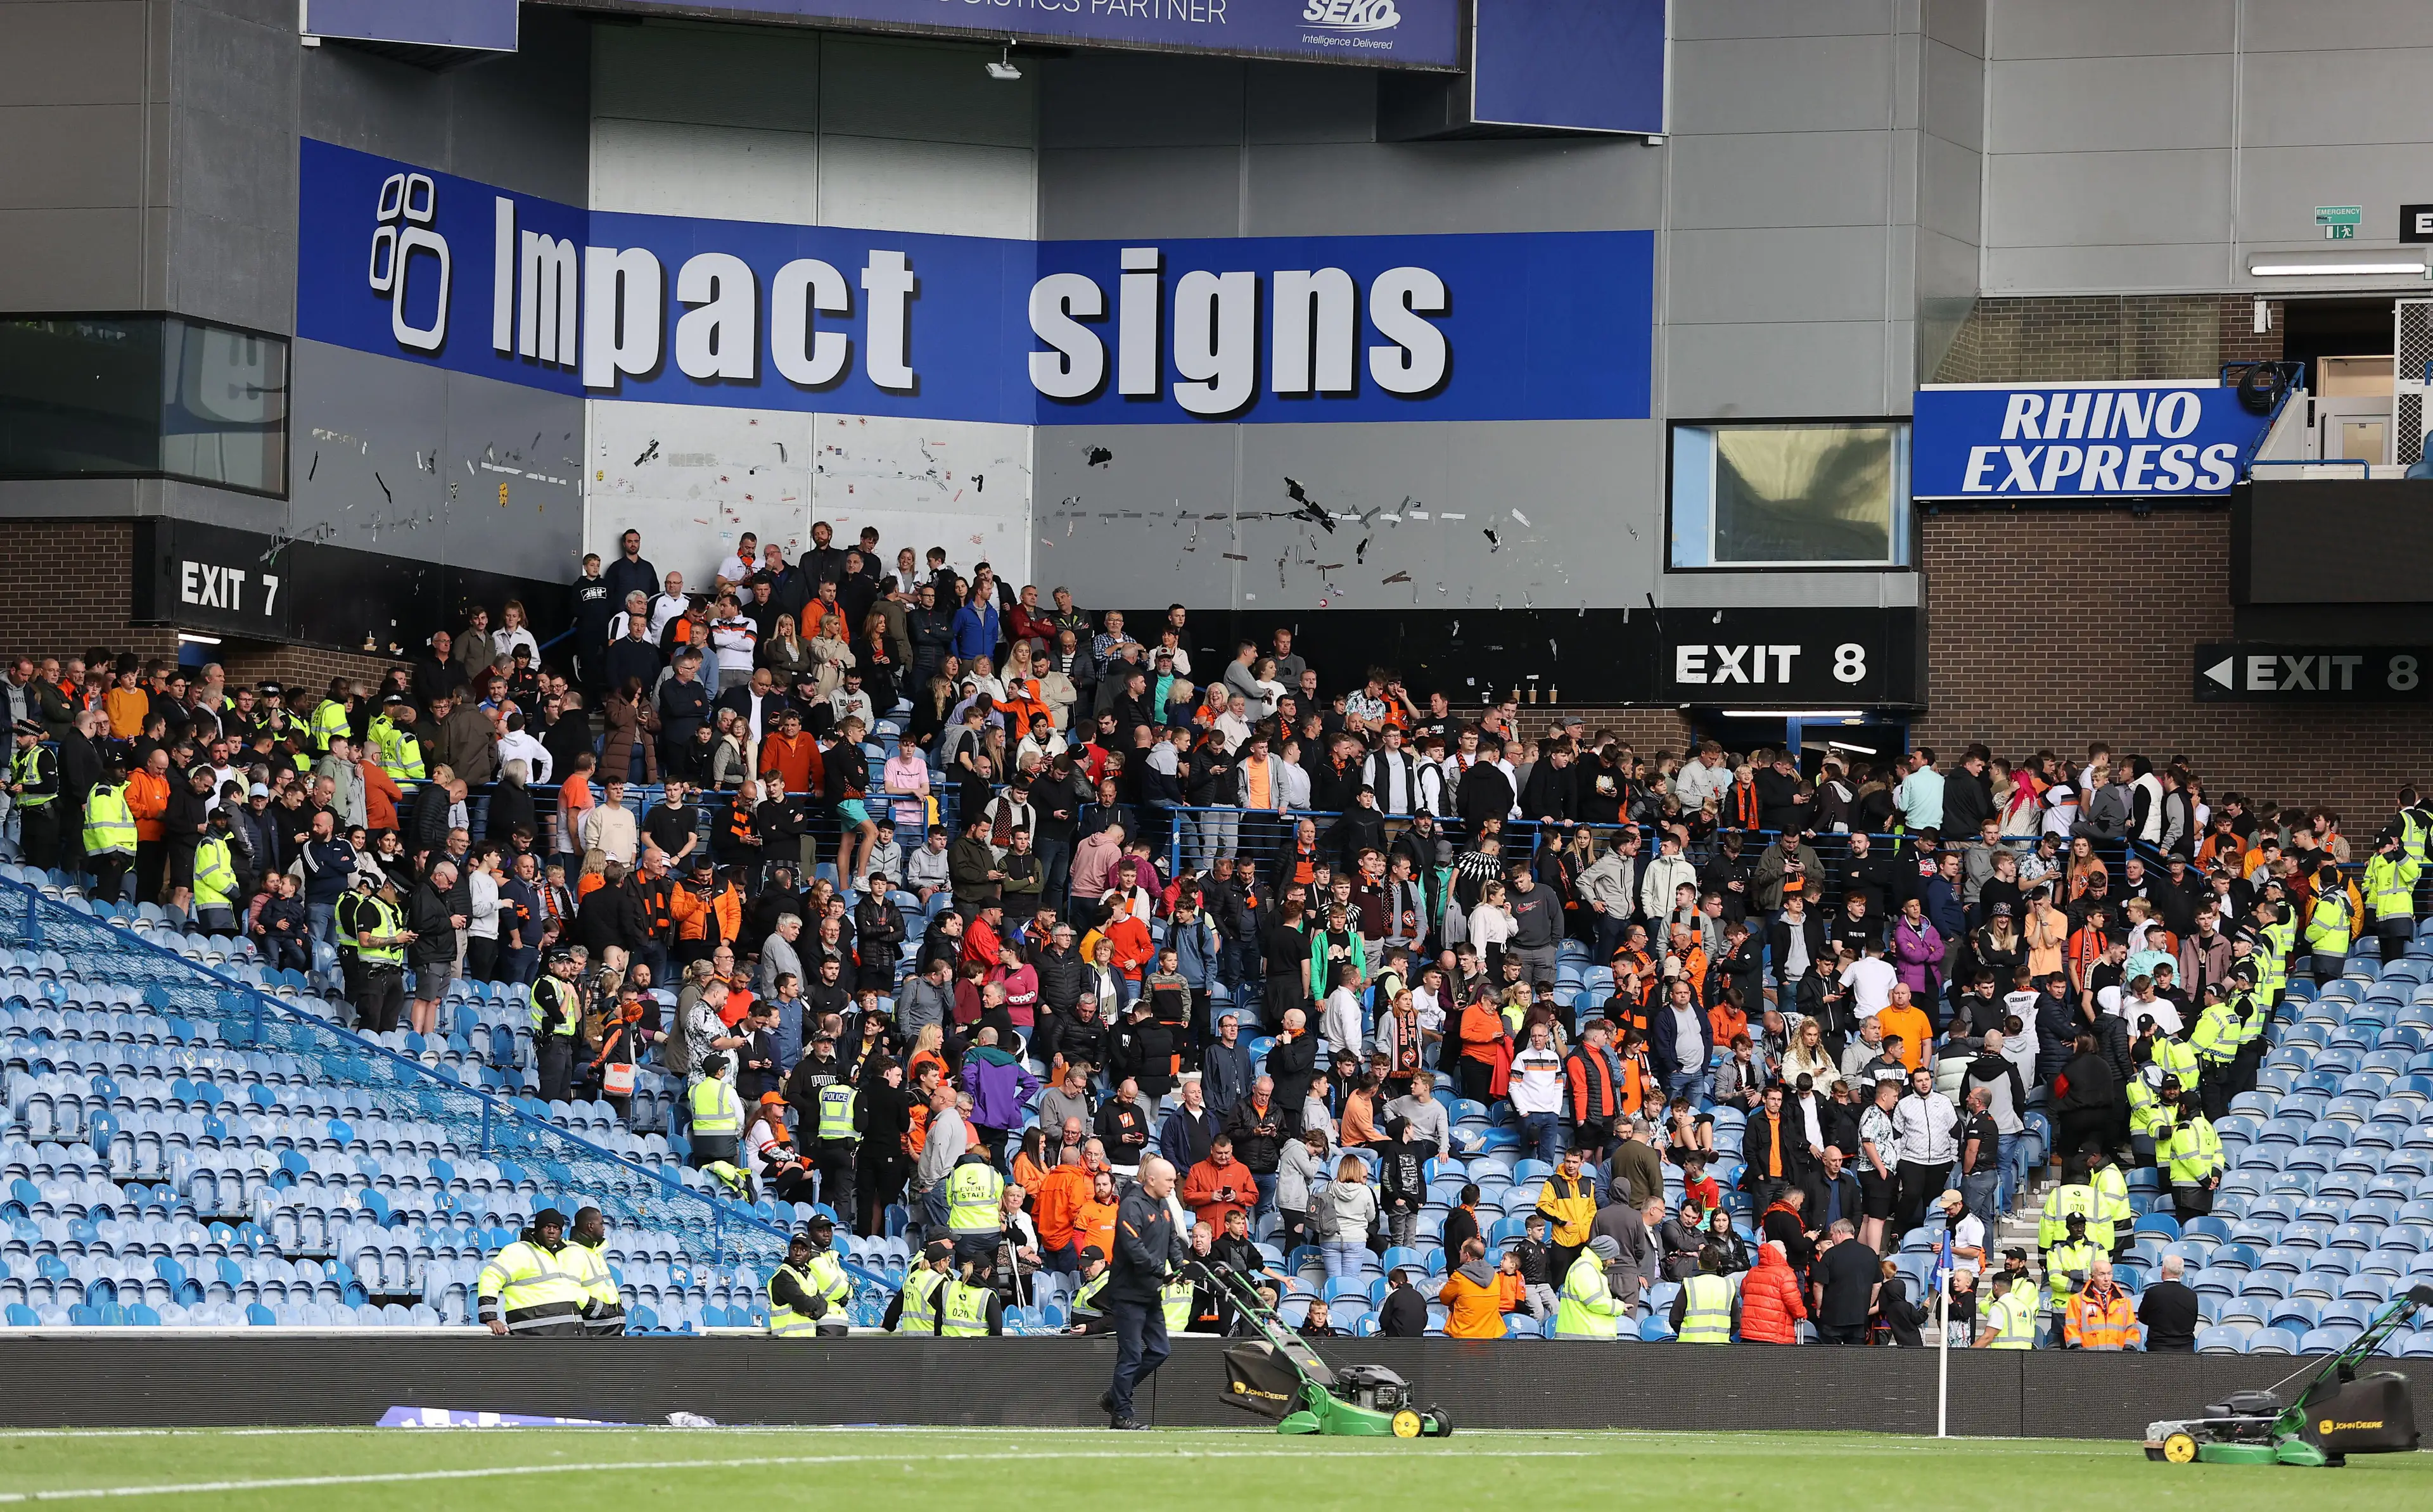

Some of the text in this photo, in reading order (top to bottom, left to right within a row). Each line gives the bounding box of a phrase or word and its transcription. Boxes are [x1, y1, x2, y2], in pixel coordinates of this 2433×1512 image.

[1303, 0, 1398, 25] SEKO
[1302, 34, 1393, 49] Intelligence Delivered
[493, 196, 1446, 414] Impact signs
[2000, 391, 2201, 440] RHINO
[1962, 443, 2238, 492] EXPRESS
[181, 561, 279, 616] EXIT 7
[1676, 643, 1867, 683] EXIT 8
[2247, 655, 2419, 691] EXIT 8
[810, 1075, 838, 1088] PUM
[823, 1091, 848, 1102] POLICE
[952, 1307, 967, 1318] 020
[1246, 1388, 1289, 1401] JOHN DEERE
[2334, 1420, 2383, 1430] JOHN DEERE
